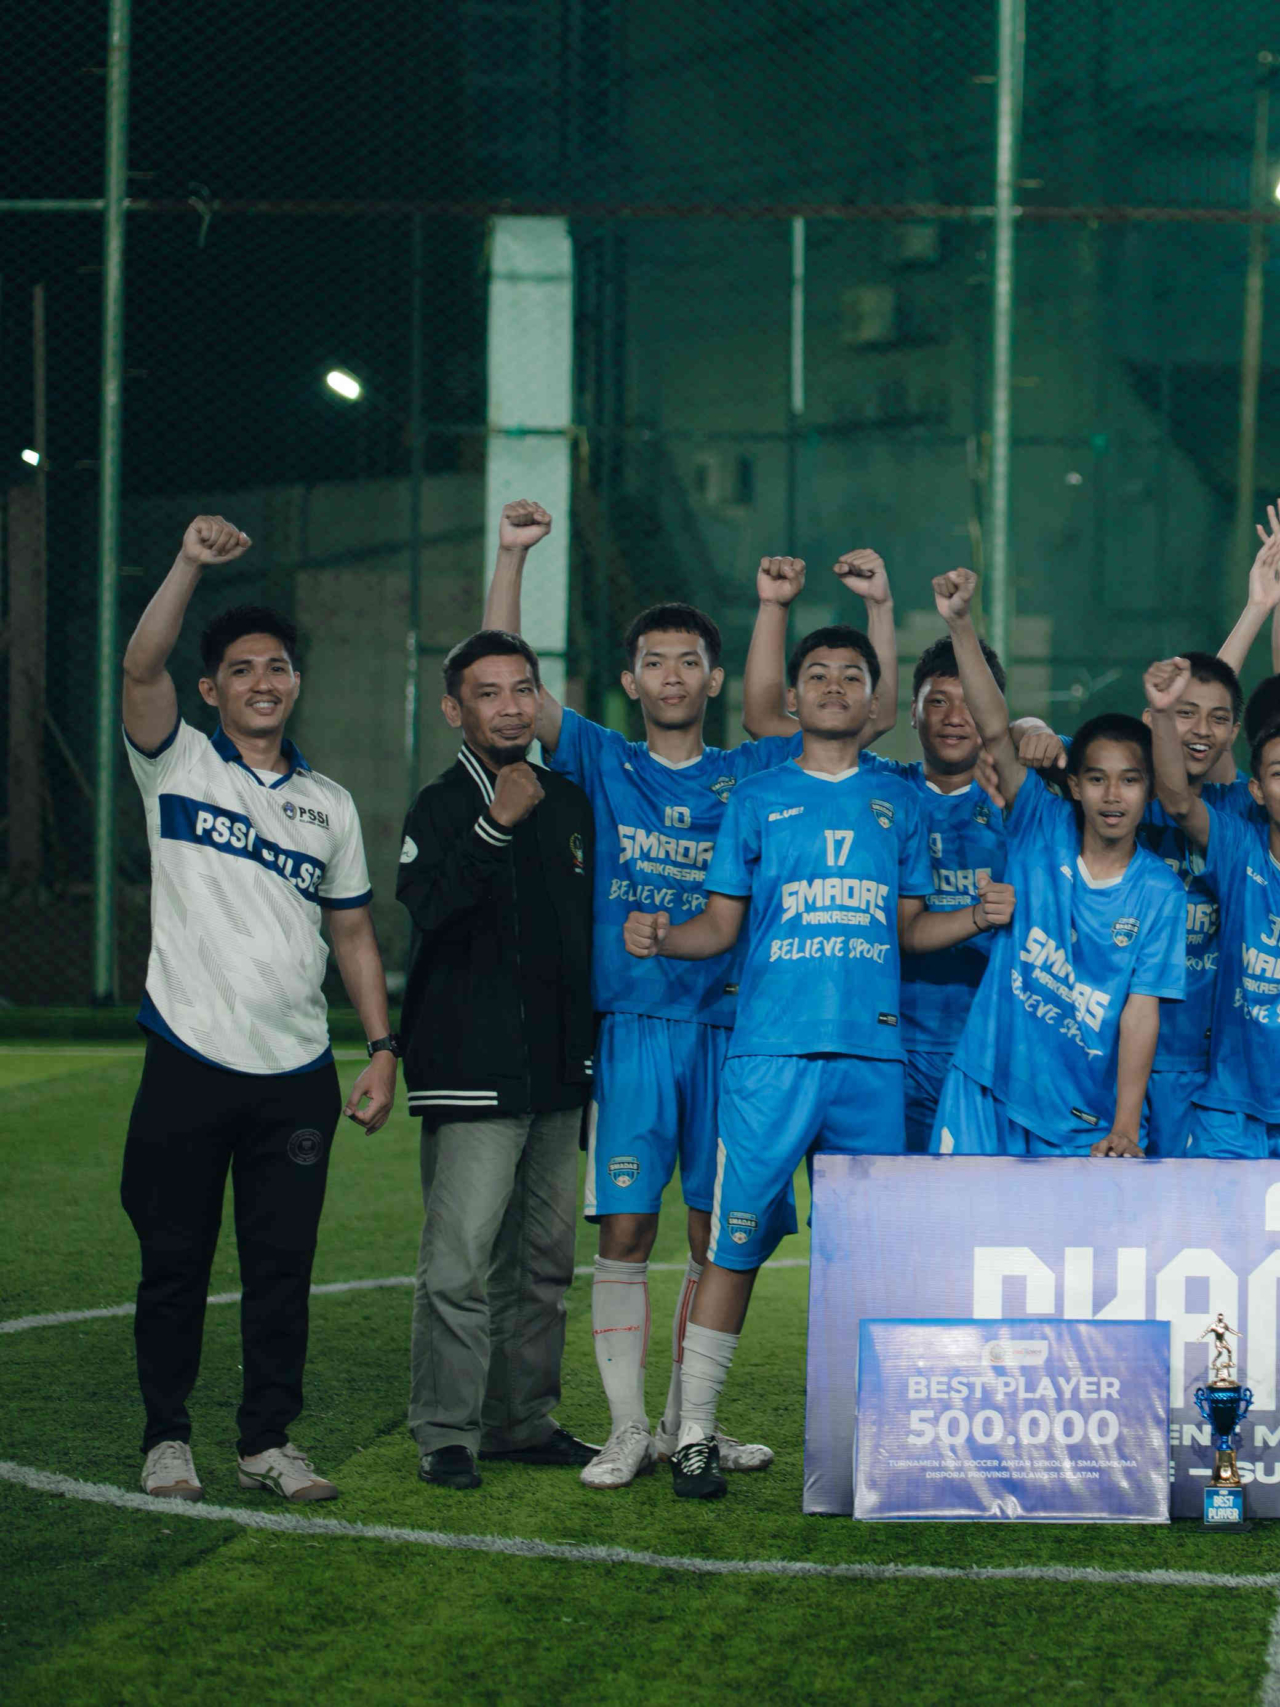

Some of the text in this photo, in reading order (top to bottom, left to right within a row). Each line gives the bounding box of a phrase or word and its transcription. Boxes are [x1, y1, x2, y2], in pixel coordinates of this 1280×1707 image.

[299, 807, 329, 827] PSSI
[664, 806, 692, 829] 10
[196, 811, 257, 852] PSSI
[618, 824, 714, 867] SMADA
[824, 829, 855, 867] 17
[609, 878, 677, 908] BELIEVE
[802, 910, 871, 926] MAKASSAR
[769, 936, 891, 964] BELIEVE SPORT
[908, 1376, 1120, 1399] BEST PLAYER
[907, 1409, 1120, 1445] 500.000
[888, 1459, 939, 1468] TURNAMEN
[963, 1459, 999, 1468] SOCCER
[926, 1470, 966, 1480] DISPORA
[968, 1470, 1010, 1480] PROVINSI
[1213, 1495, 1234, 1507] BEST
[1208, 1507, 1239, 1520] PLAYER
